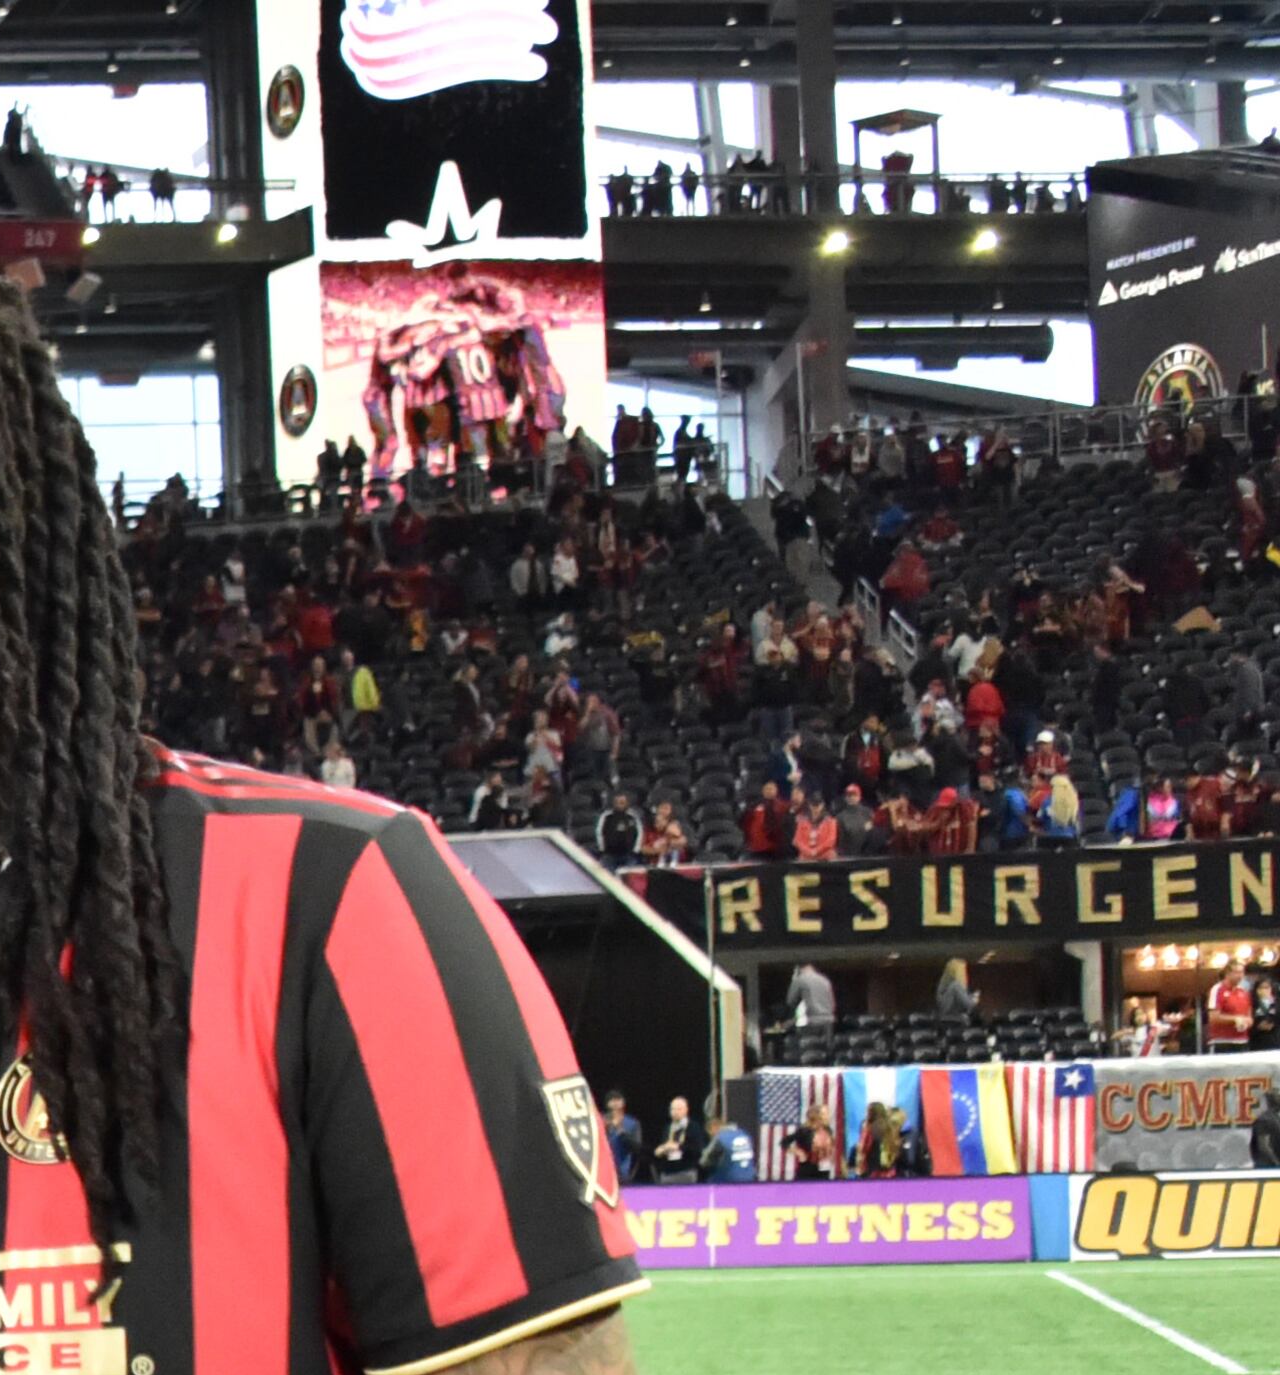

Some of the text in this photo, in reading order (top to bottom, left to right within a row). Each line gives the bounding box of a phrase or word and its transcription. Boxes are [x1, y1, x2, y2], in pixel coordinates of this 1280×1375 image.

[1119, 265, 1205, 300] Georgia Power
[456, 342, 491, 384] 10
[718, 851, 1276, 934] RESURGEN
[625, 1200, 1015, 1249] NET FITNESS
